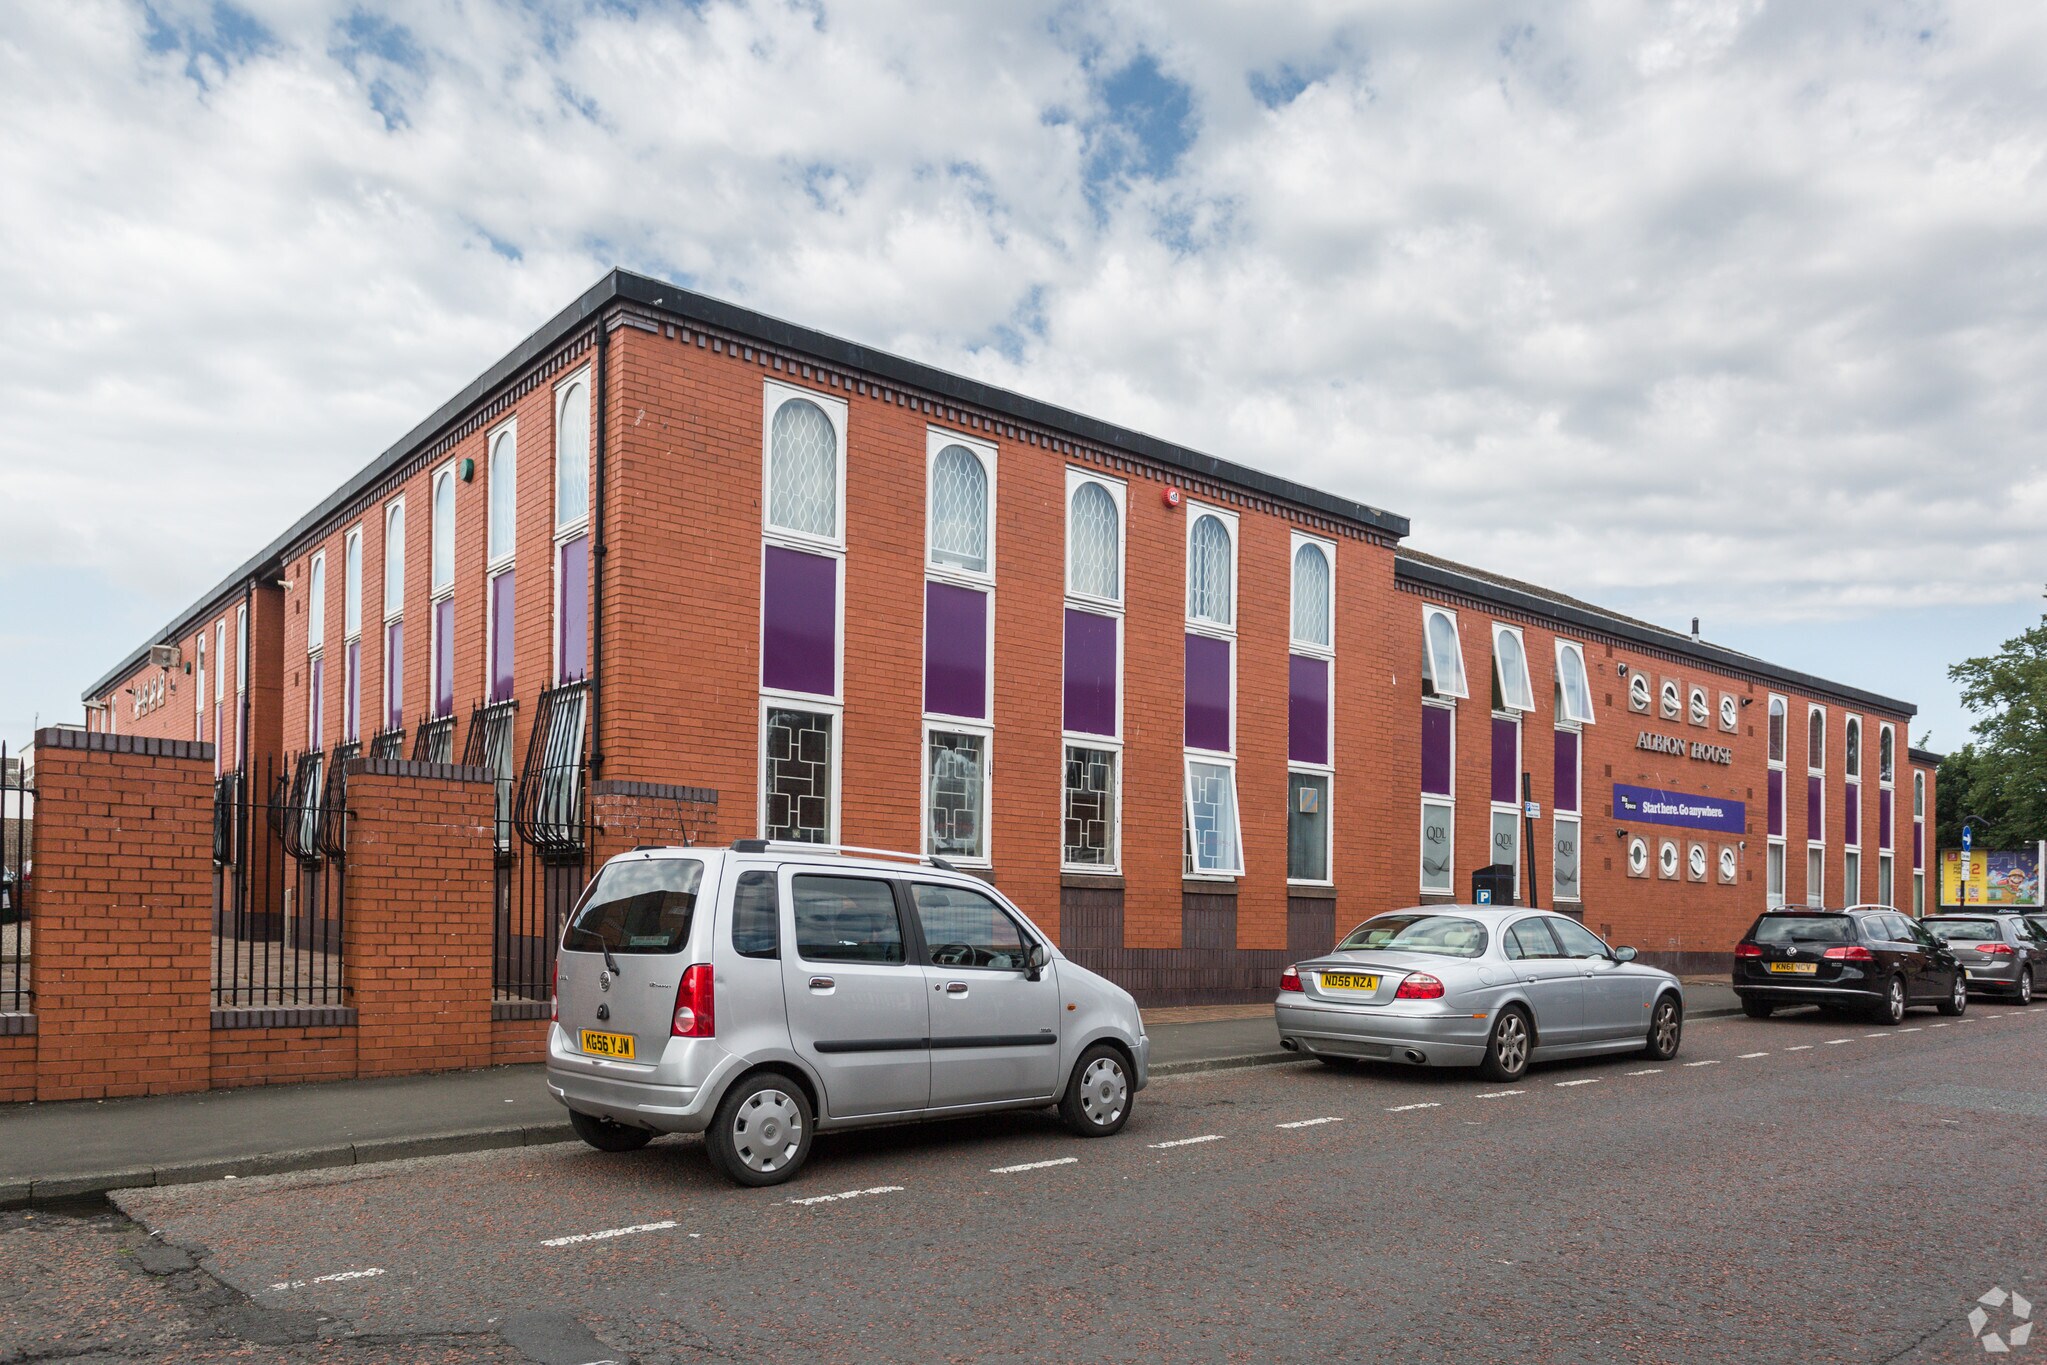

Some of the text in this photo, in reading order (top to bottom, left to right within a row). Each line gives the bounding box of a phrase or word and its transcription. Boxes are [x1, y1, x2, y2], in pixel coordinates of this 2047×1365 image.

[1635, 731, 1733, 766] ALBION HOUSE
[1642, 801, 1724, 818] Start here. Go anywhere.
[1426, 825, 1446, 845] QDL
[1495, 832, 1513, 850] QDL
[1557, 839, 1573, 857] QDL
[1971, 863, 1981, 875] 2
[1480, 891, 1489, 902] P
[1325, 974, 1372, 989] ND56 NZA
[585, 1033, 630, 1055] KG56 YJW
